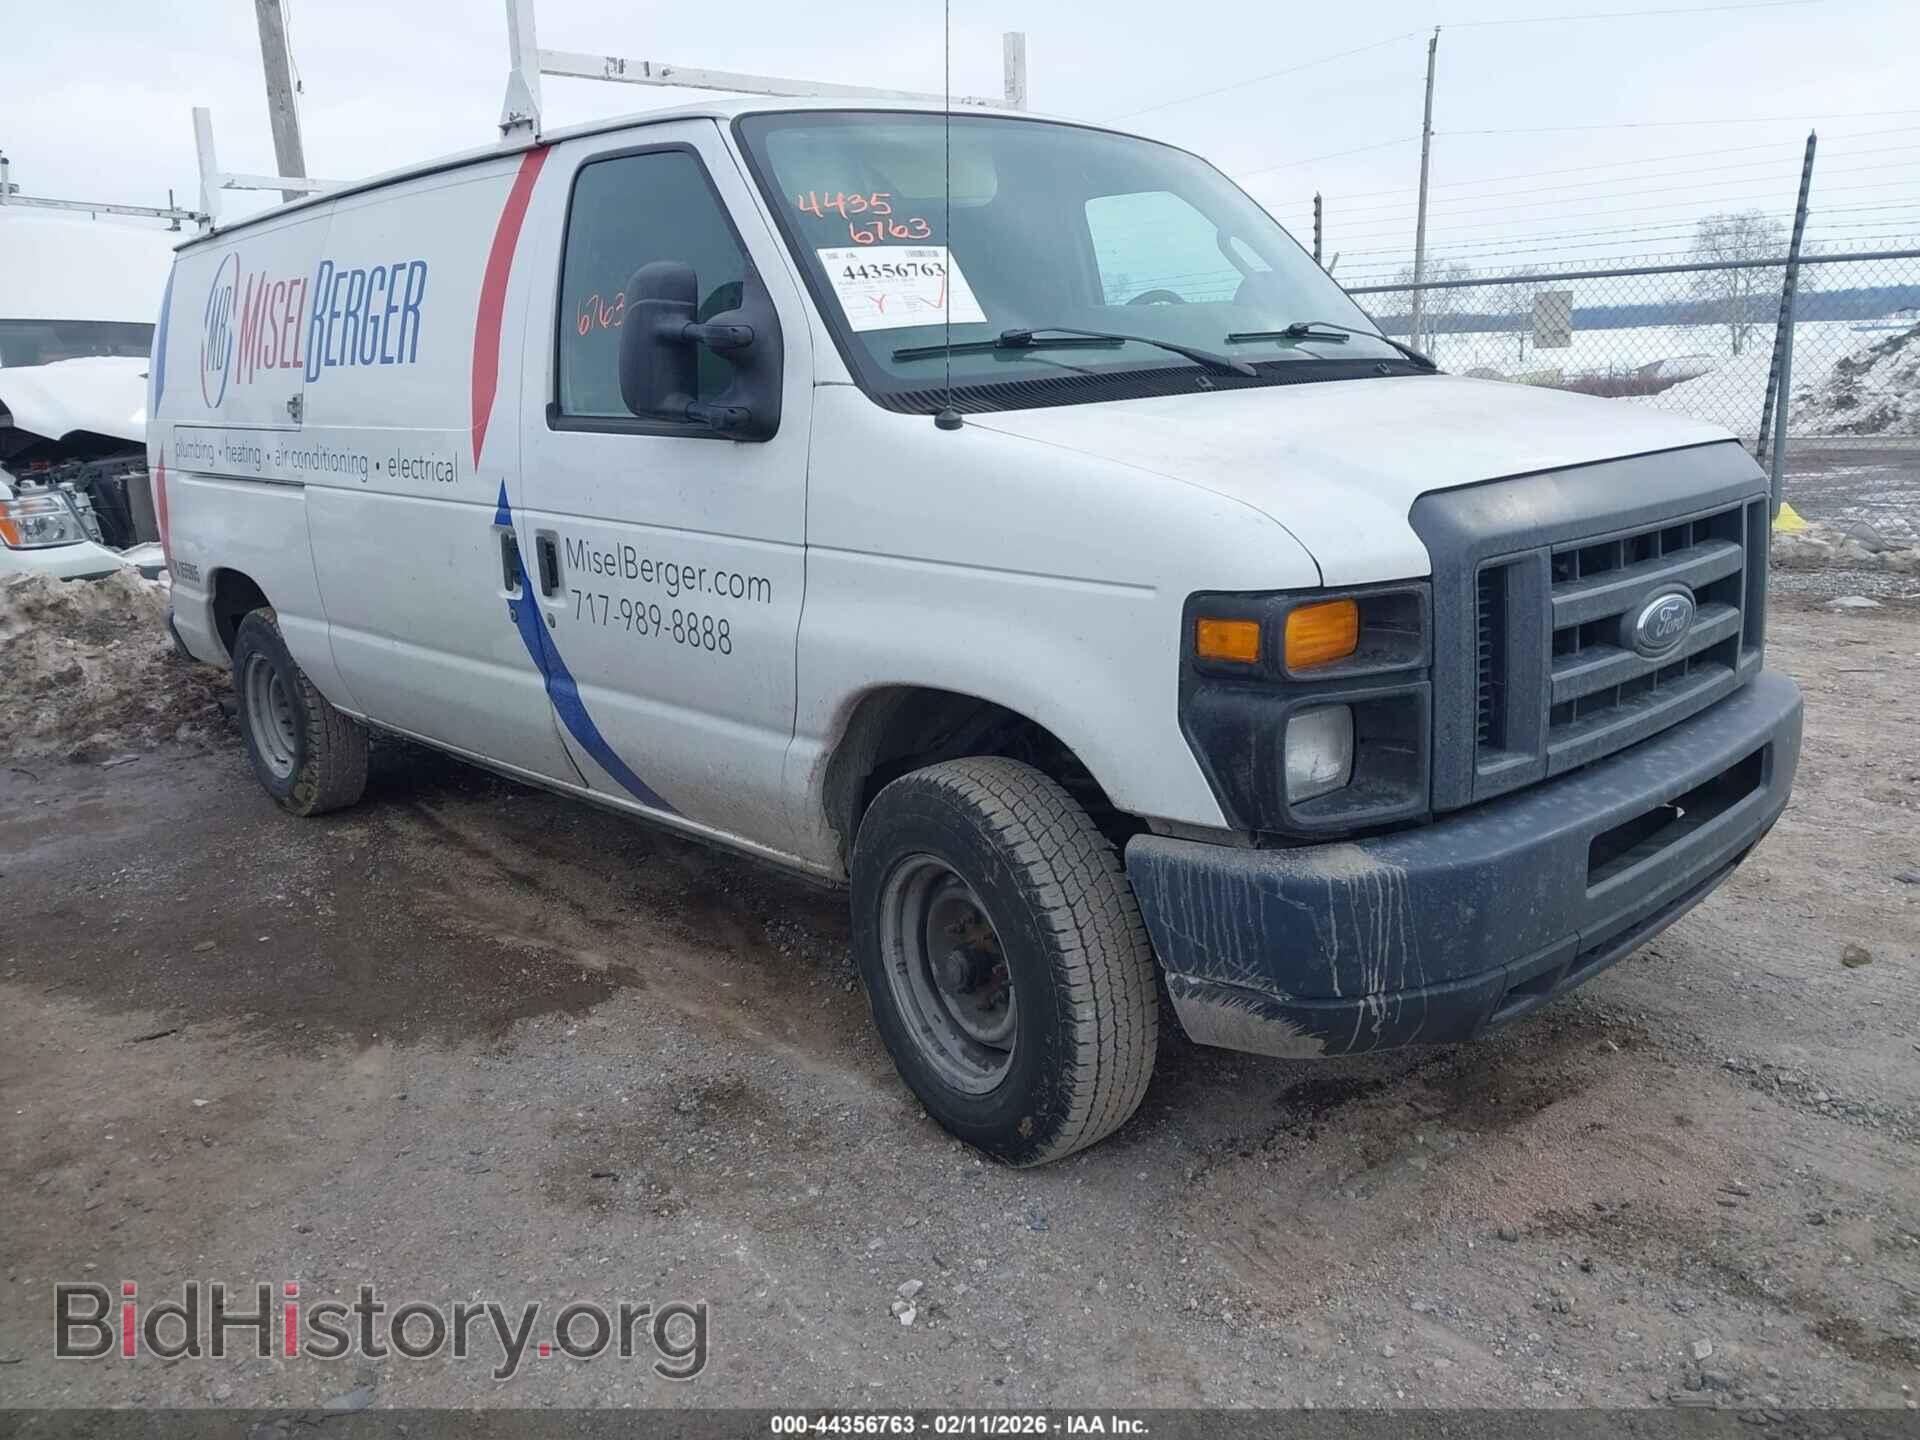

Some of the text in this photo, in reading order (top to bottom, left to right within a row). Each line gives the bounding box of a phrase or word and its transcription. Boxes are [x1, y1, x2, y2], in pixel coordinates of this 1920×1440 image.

[798, 191, 892, 219] 4435
[849, 218, 931, 244] 6763
[843, 263, 946, 280] 44356763
[225, 436, 262, 472] heating
[275, 441, 289, 467] air
[291, 443, 369, 483] conditioning
[387, 447, 459, 483] electrical
[565, 537, 772, 603] MiselBerger.com
[571, 589, 733, 655] 717-989-8888
[1656, 604, 1686, 637] Ford
